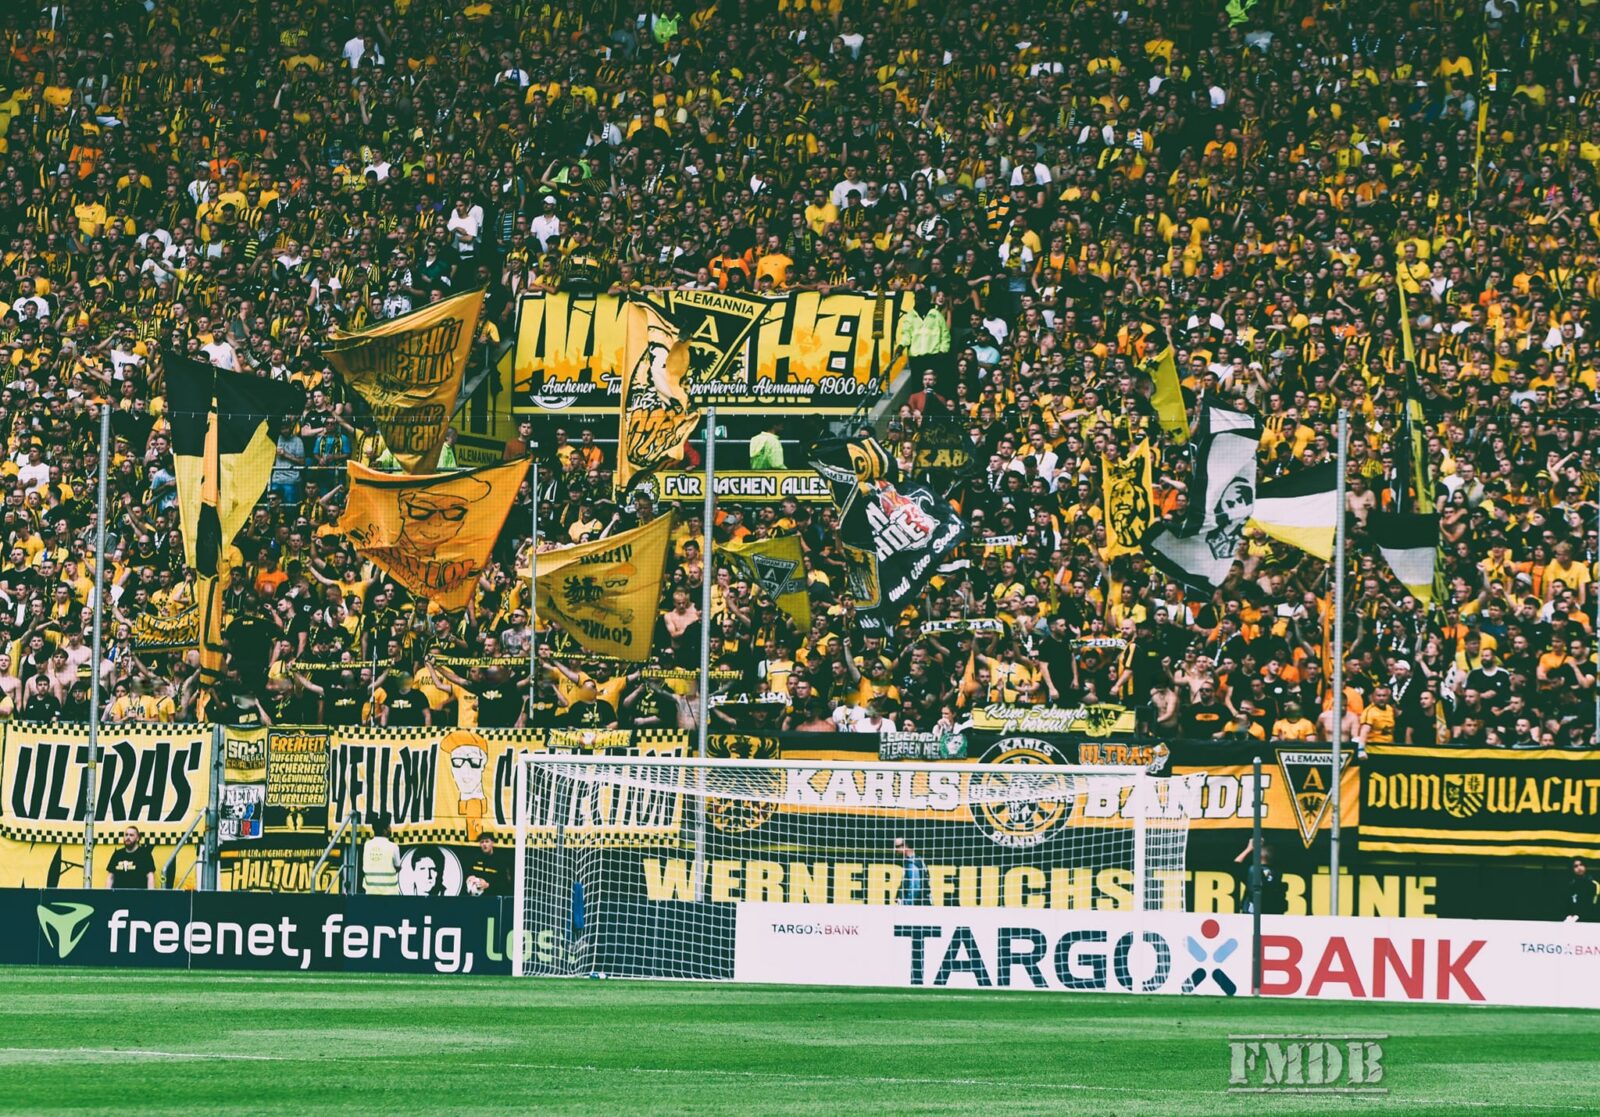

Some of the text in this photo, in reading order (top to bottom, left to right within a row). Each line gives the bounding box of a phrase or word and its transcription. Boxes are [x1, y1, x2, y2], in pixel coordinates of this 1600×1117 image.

[674, 290, 755, 315] ALEMANNIA
[693, 315, 719, 342] A
[541, 375, 597, 394] Aachener
[752, 374, 815, 396] Alemannia
[819, 376, 856, 395] 1900
[666, 475, 700, 496] FÜR
[447, 656, 525, 666] ULTRAS AACHEN
[270, 735, 327, 752] FREIHEIT
[998, 738, 1055, 757] KARLS
[1079, 744, 1154, 765] ULTRAS
[1284, 753, 1344, 764] ALEMANN
[269, 774, 279, 783] ZU
[270, 763, 326, 774] SICHERHEIT
[1302, 766, 1325, 791] A
[12, 741, 203, 822] ULTRAS
[331, 743, 438, 825] YELLOW
[1368, 771, 1442, 812] DOM
[226, 788, 260, 804] NEIN
[268, 793, 324, 804] ZU VERLIEREN
[785, 769, 961, 811] KARLS
[1082, 773, 1272, 819] BANDE
[221, 820, 238, 836] ZU
[232, 858, 331, 891] HALTUNG
[643, 857, 1438, 919] WERNER FUCHS TRBÜNE
[771, 923, 859, 935] TARGO BANK
[107, 909, 312, 969] freenet,
[321, 913, 474, 973] fertig,
[1520, 943, 1563, 955] TARGO
[893, 923, 1487, 1001] TARGO BANK
